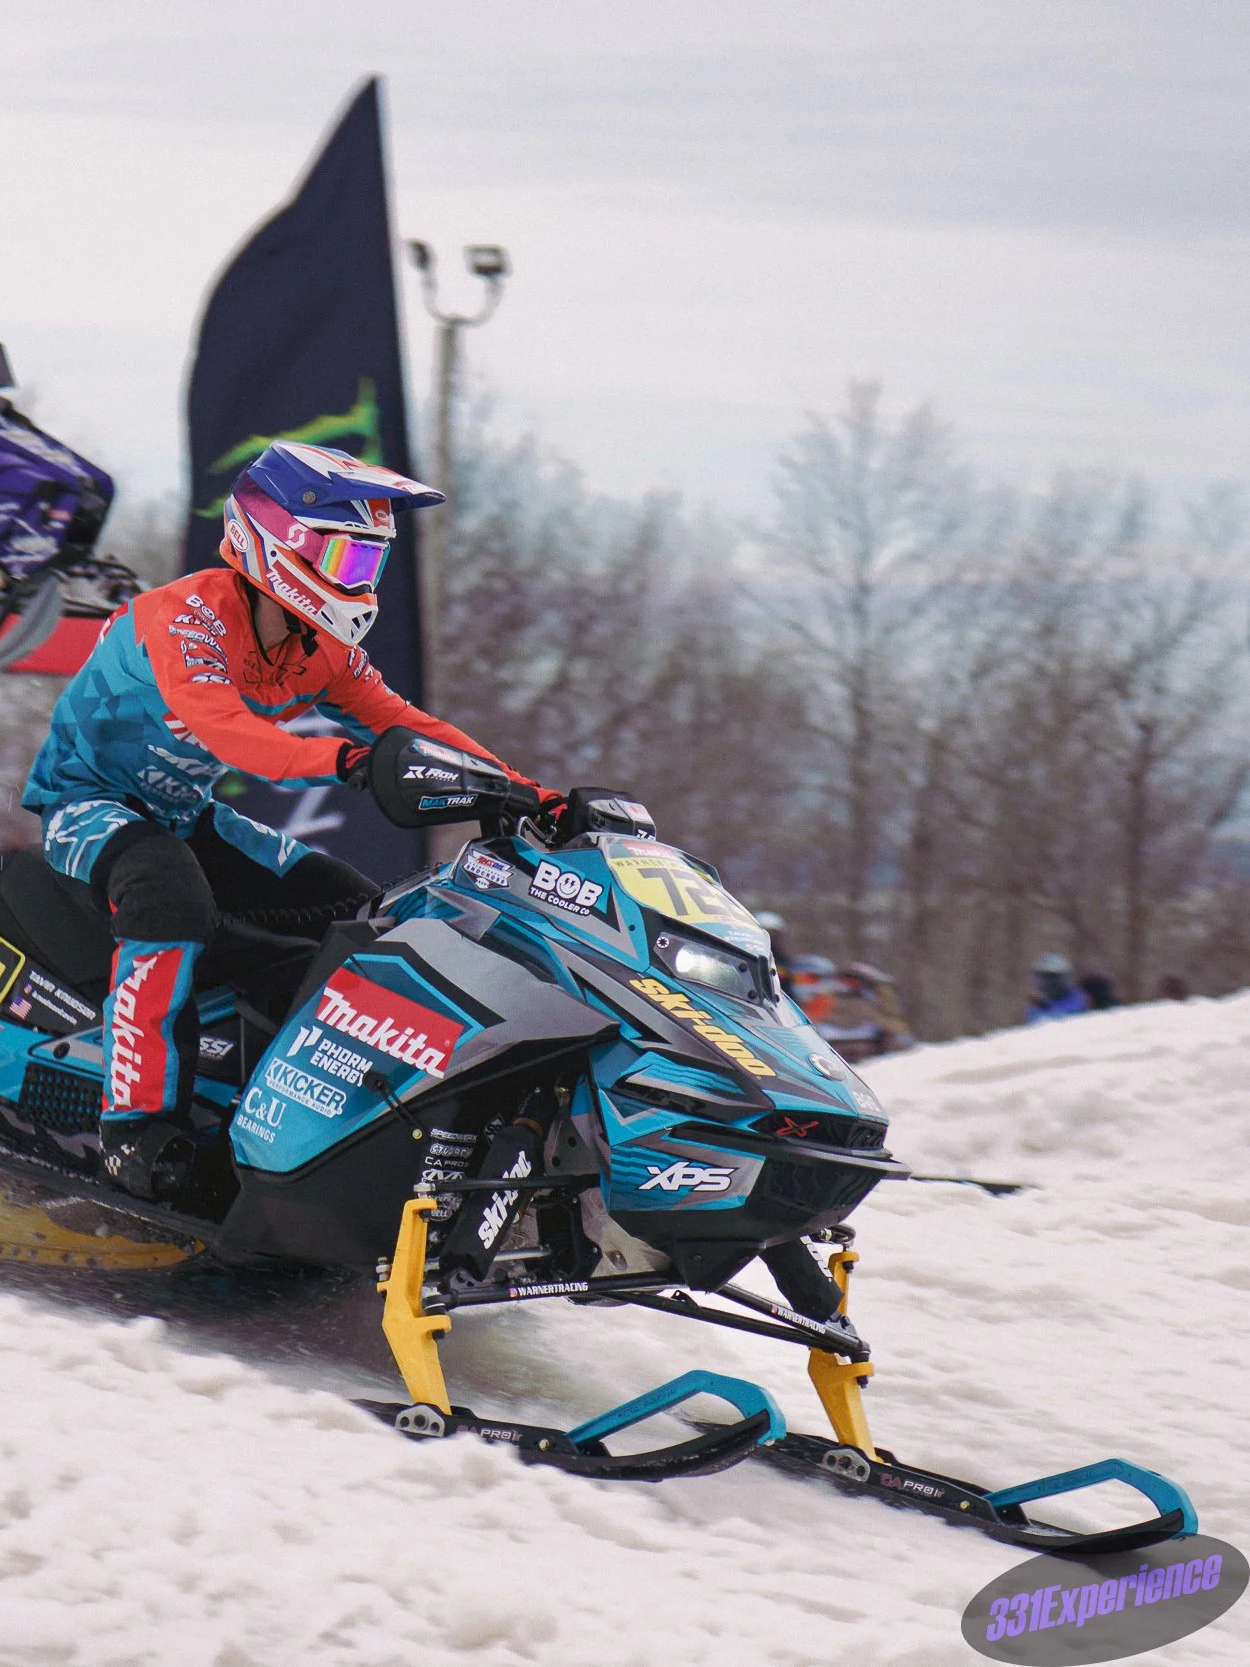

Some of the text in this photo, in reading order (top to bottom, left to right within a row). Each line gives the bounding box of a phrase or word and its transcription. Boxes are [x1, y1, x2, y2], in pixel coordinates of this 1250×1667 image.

[228, 525, 246, 549] BELL
[266, 569, 318, 616] makita
[530, 887, 591, 916] THE COOLER CO
[532, 862, 603, 906] BOB
[314, 987, 446, 1080] makita
[317, 1037, 373, 1073] PHORM
[267, 1061, 346, 1112] KICKER
[245, 1087, 287, 1127] C&U
[237, 1114, 276, 1143] BEARINGS
[639, 1161, 737, 1192] XPS
[518, 1282, 589, 1297] WARNERTRACING
